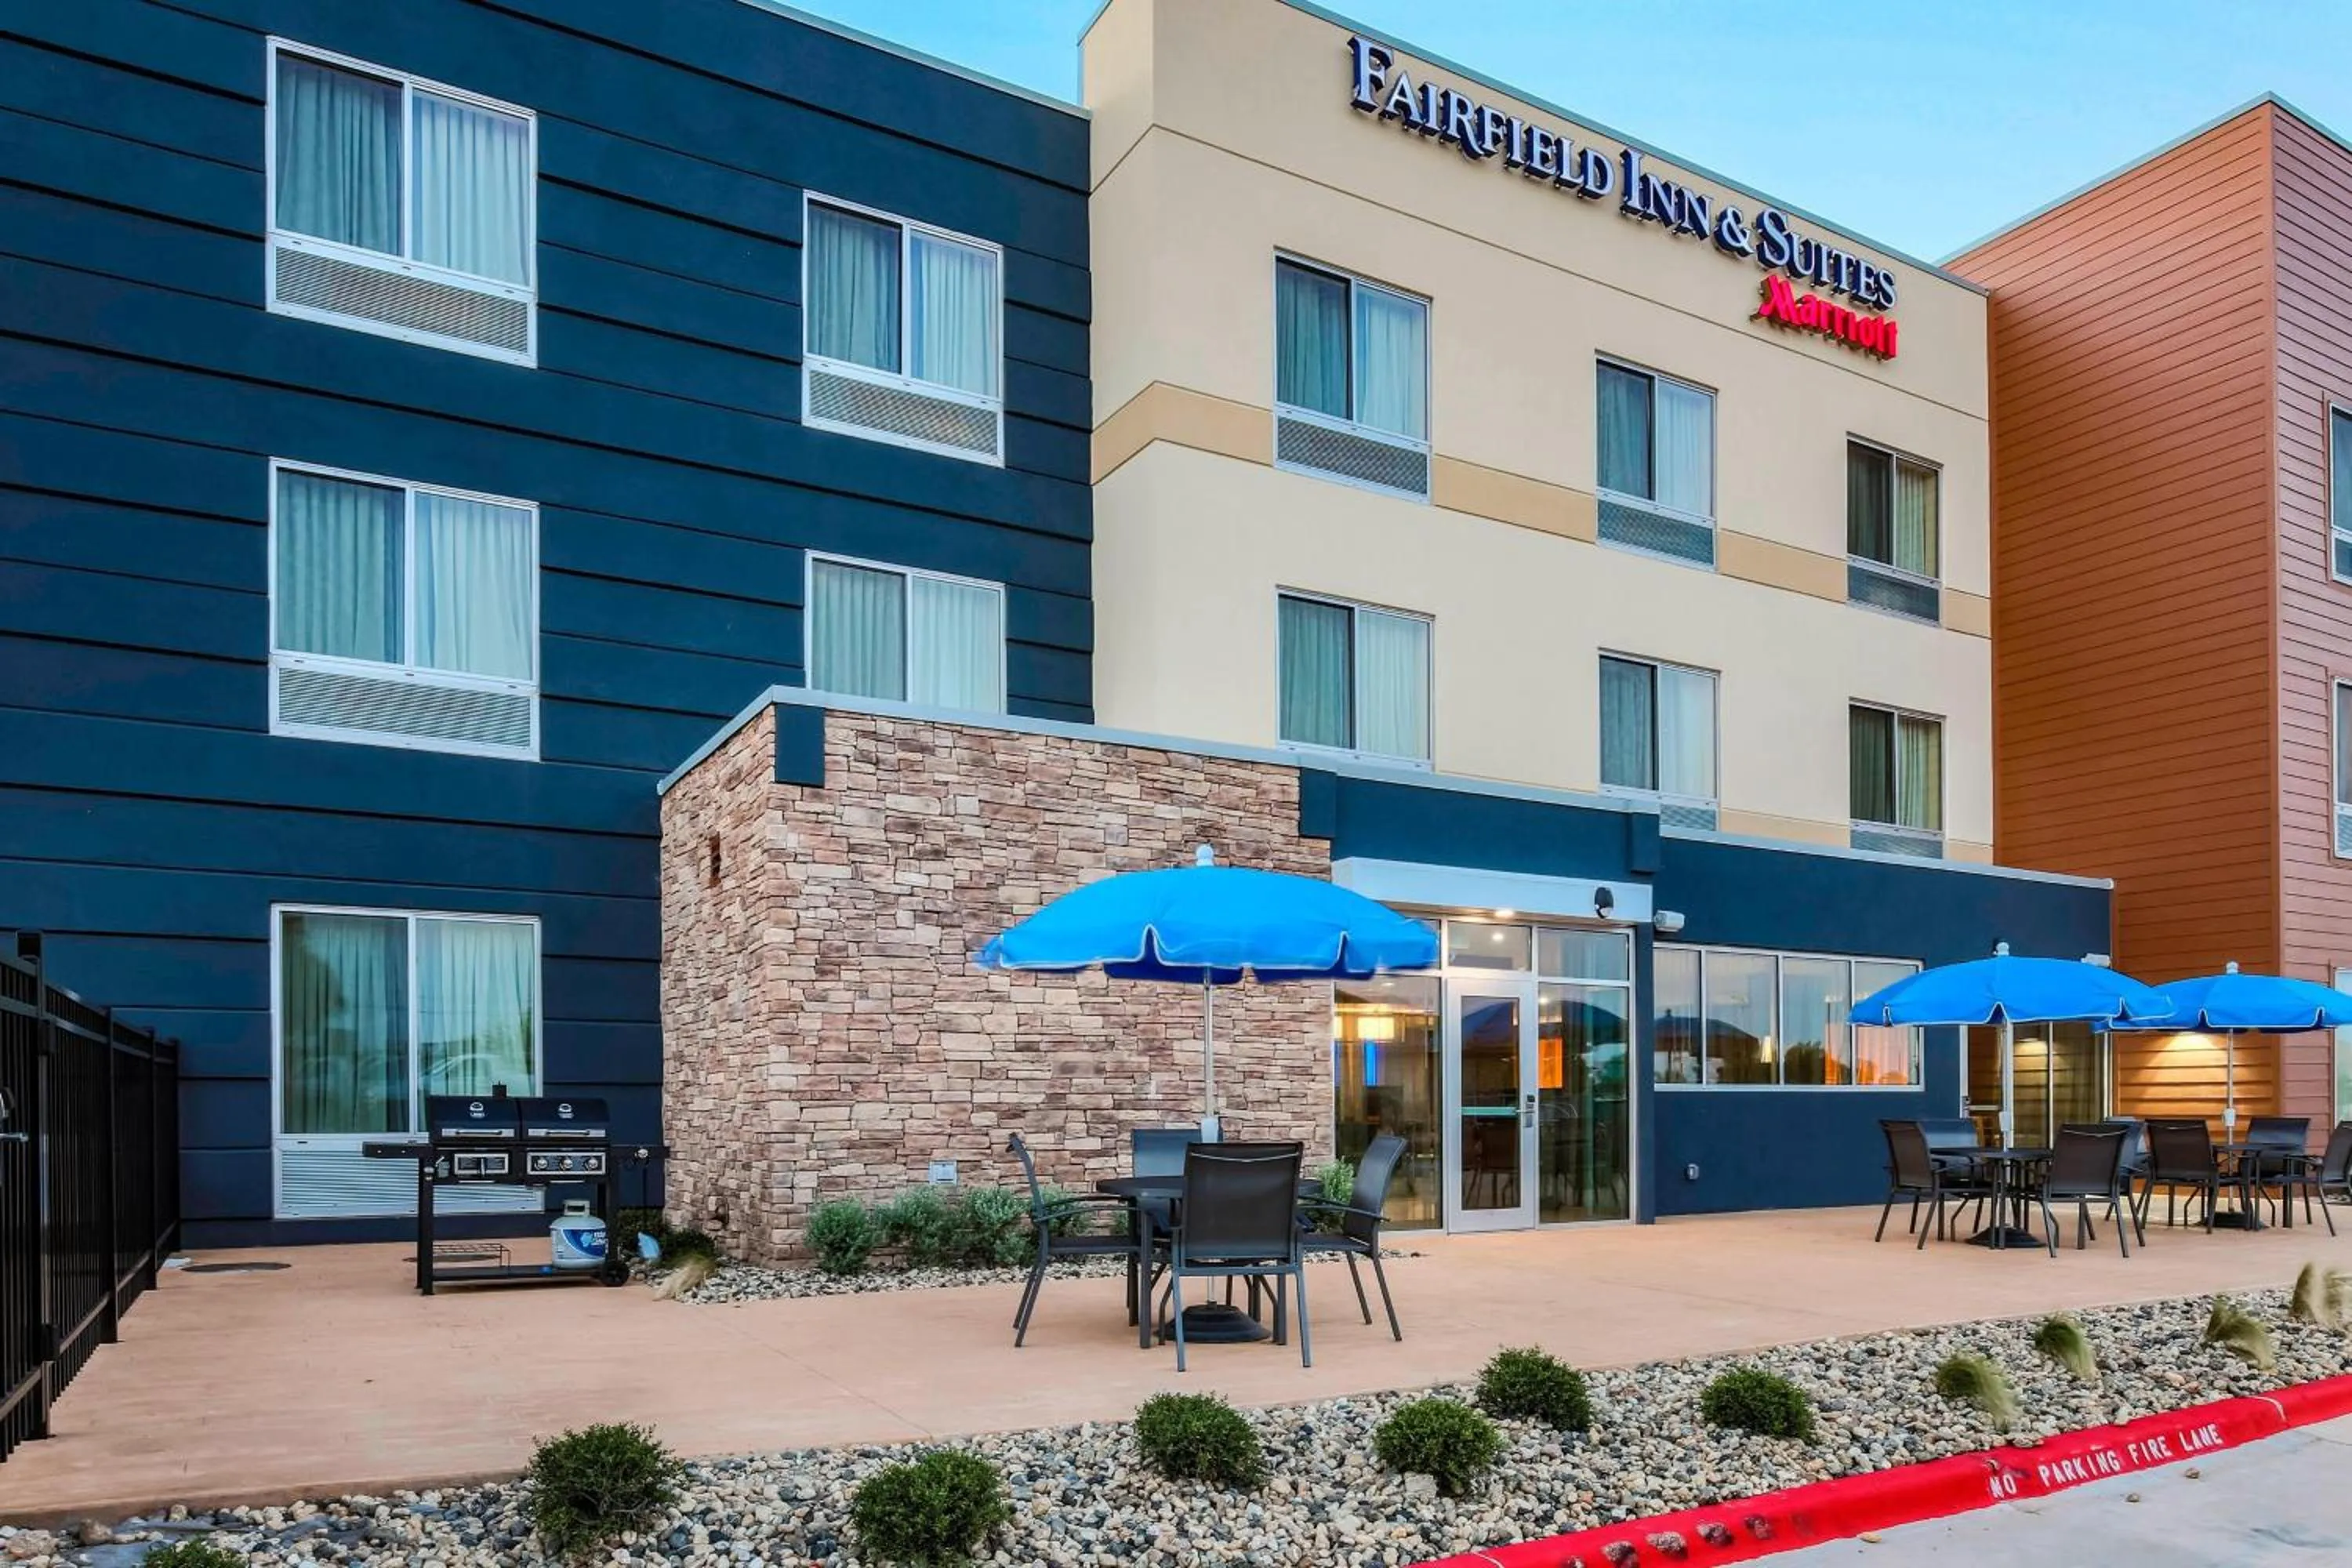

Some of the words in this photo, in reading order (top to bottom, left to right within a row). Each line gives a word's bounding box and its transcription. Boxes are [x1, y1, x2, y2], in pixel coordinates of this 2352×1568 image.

[1348, 35, 1616, 199] FAIRFIELD
[1620, 150, 1715, 241] INN
[1712, 206, 1754, 258] &
[1755, 208, 1897, 312] SUITES
[1756, 275, 1897, 360] Marriott
[1989, 1475, 2016, 1498] NO
[2038, 1450, 2121, 1487] PARKING
[2128, 1436, 2172, 1465] FIRE
[2179, 1423, 2223, 1451] LANE
